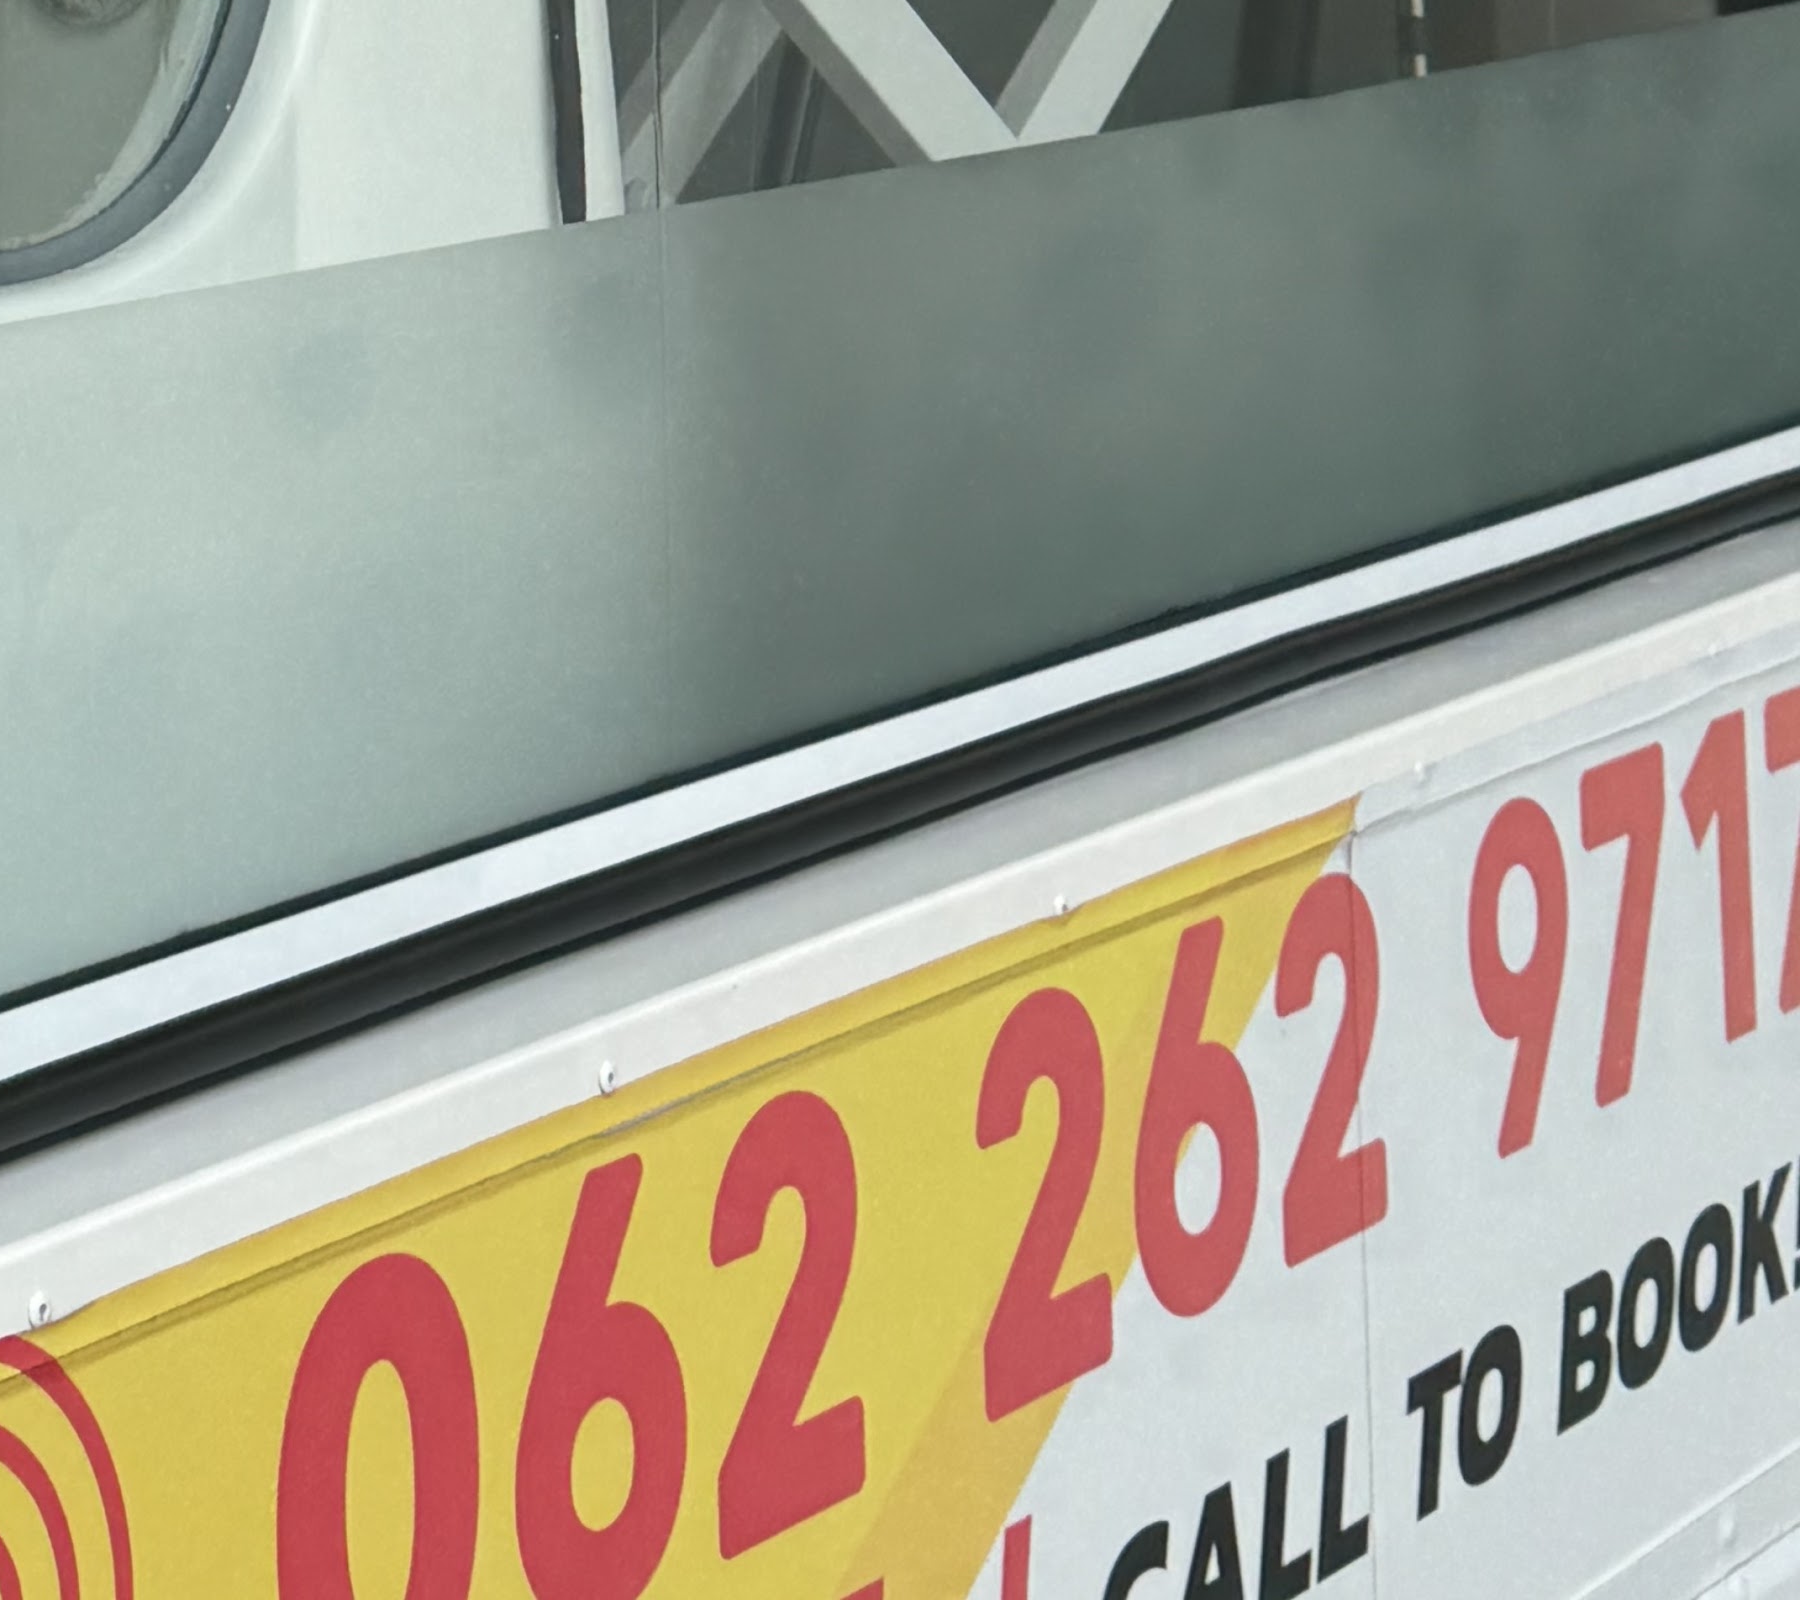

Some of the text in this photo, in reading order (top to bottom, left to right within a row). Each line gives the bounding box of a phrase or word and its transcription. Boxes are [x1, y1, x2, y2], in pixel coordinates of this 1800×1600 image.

[276, 1089, 867, 1600] 062
[975, 872, 1389, 1423] 262
[1102, 1414, 1370, 1600] CALL
[1406, 1323, 1523, 1522] TO
